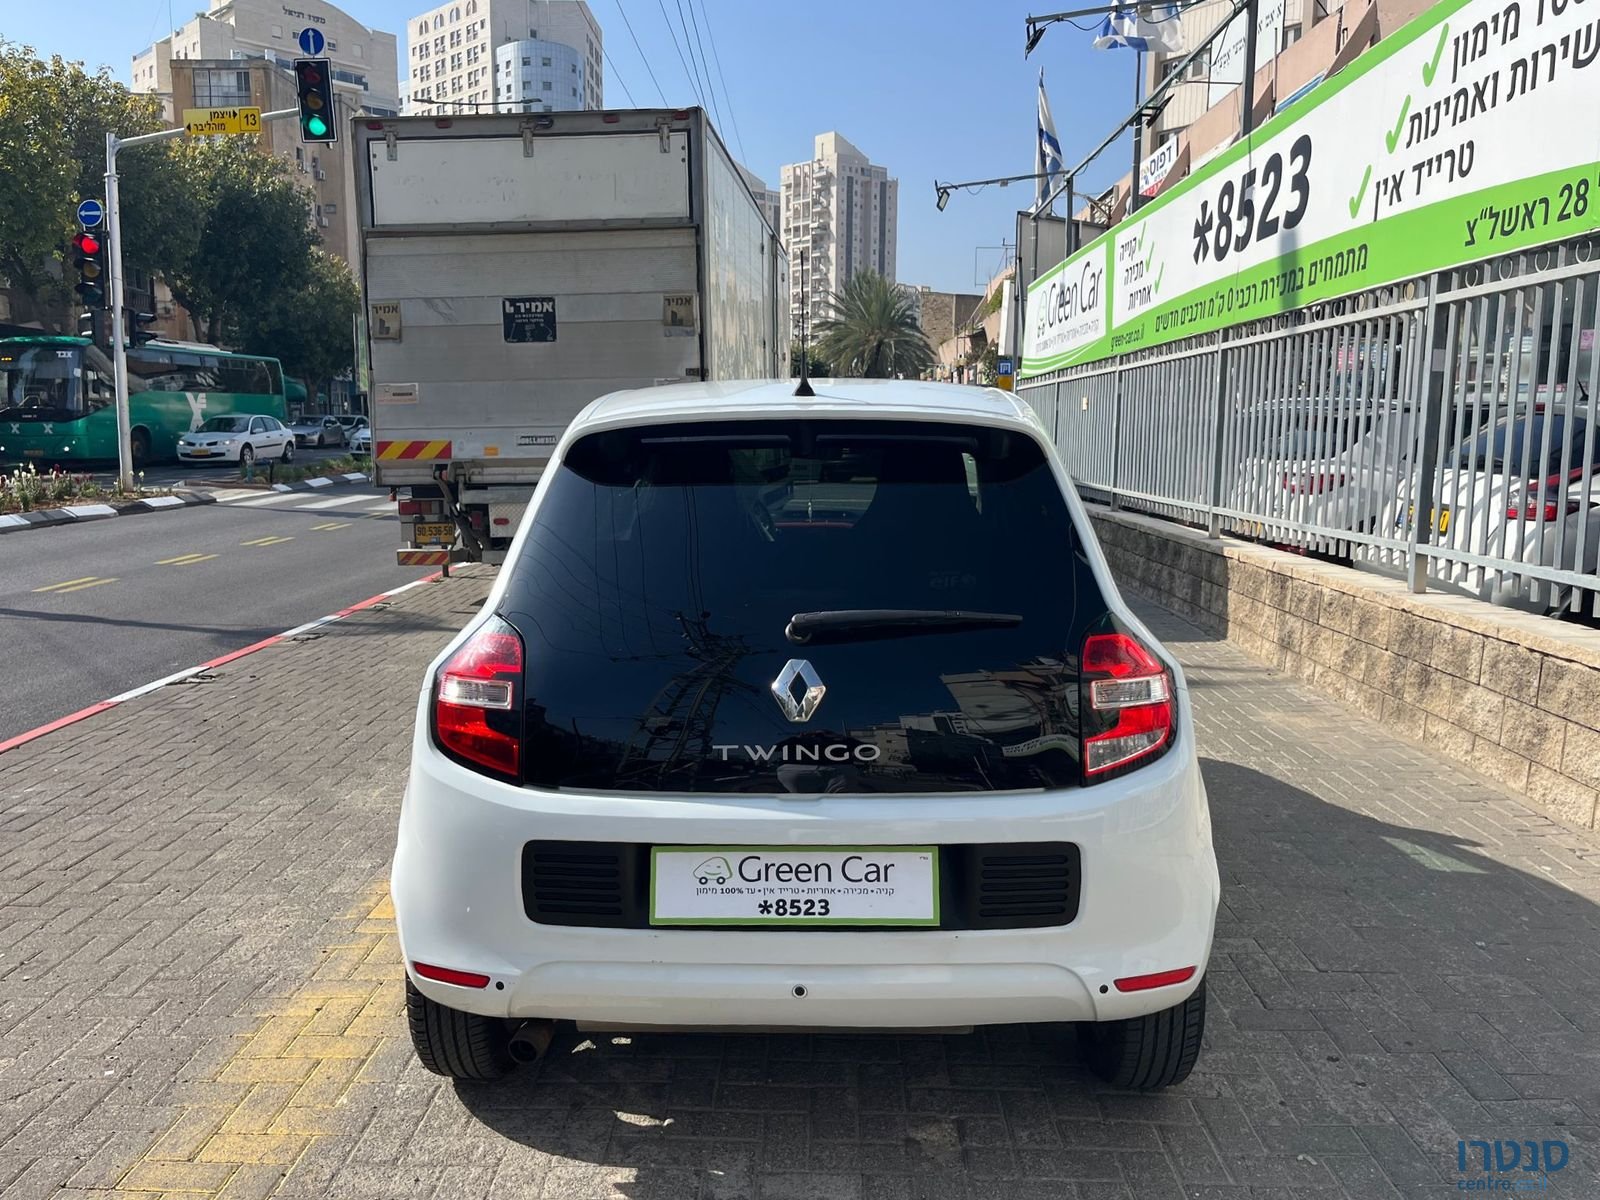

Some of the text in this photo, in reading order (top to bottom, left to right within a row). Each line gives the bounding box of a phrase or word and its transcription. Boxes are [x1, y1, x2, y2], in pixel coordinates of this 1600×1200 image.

[1452, 1, 1521, 84] מימון
[1406, 18, 1600, 149] שירות ואמינות
[193, 121, 226, 132] מוהליבר
[209, 110, 231, 121] ויצמן
[244, 113, 257, 126] 13
[1150, 145, 1172, 176] דפוס
[1373, 140, 1475, 222] טרייד אין
[1557, 178, 1590, 222] 28
[1119, 236, 1137, 262] קנייה
[1124, 260, 1144, 286] מכירה
[1308, 243, 1368, 287] מתמחים
[1047, 260, 1103, 329] Green Car
[1127, 284, 1152, 311] אחריות
[1236, 283, 1257, 309] רכבי
[1260, 266, 1304, 303] במכירת
[372, 305, 398, 314] אמיר
[516, 301, 554, 313] אמיר
[664, 297, 692, 306] אמיר
[1180, 300, 1207, 326] ורכבים
[1155, 309, 1179, 333] חדשים
[712, 744, 881, 761] TWINGO
[738, 855, 895, 883] Green Car
[696, 887, 895, 896] קניה מכירה אחריות טרייד אין עד 100% מימון
